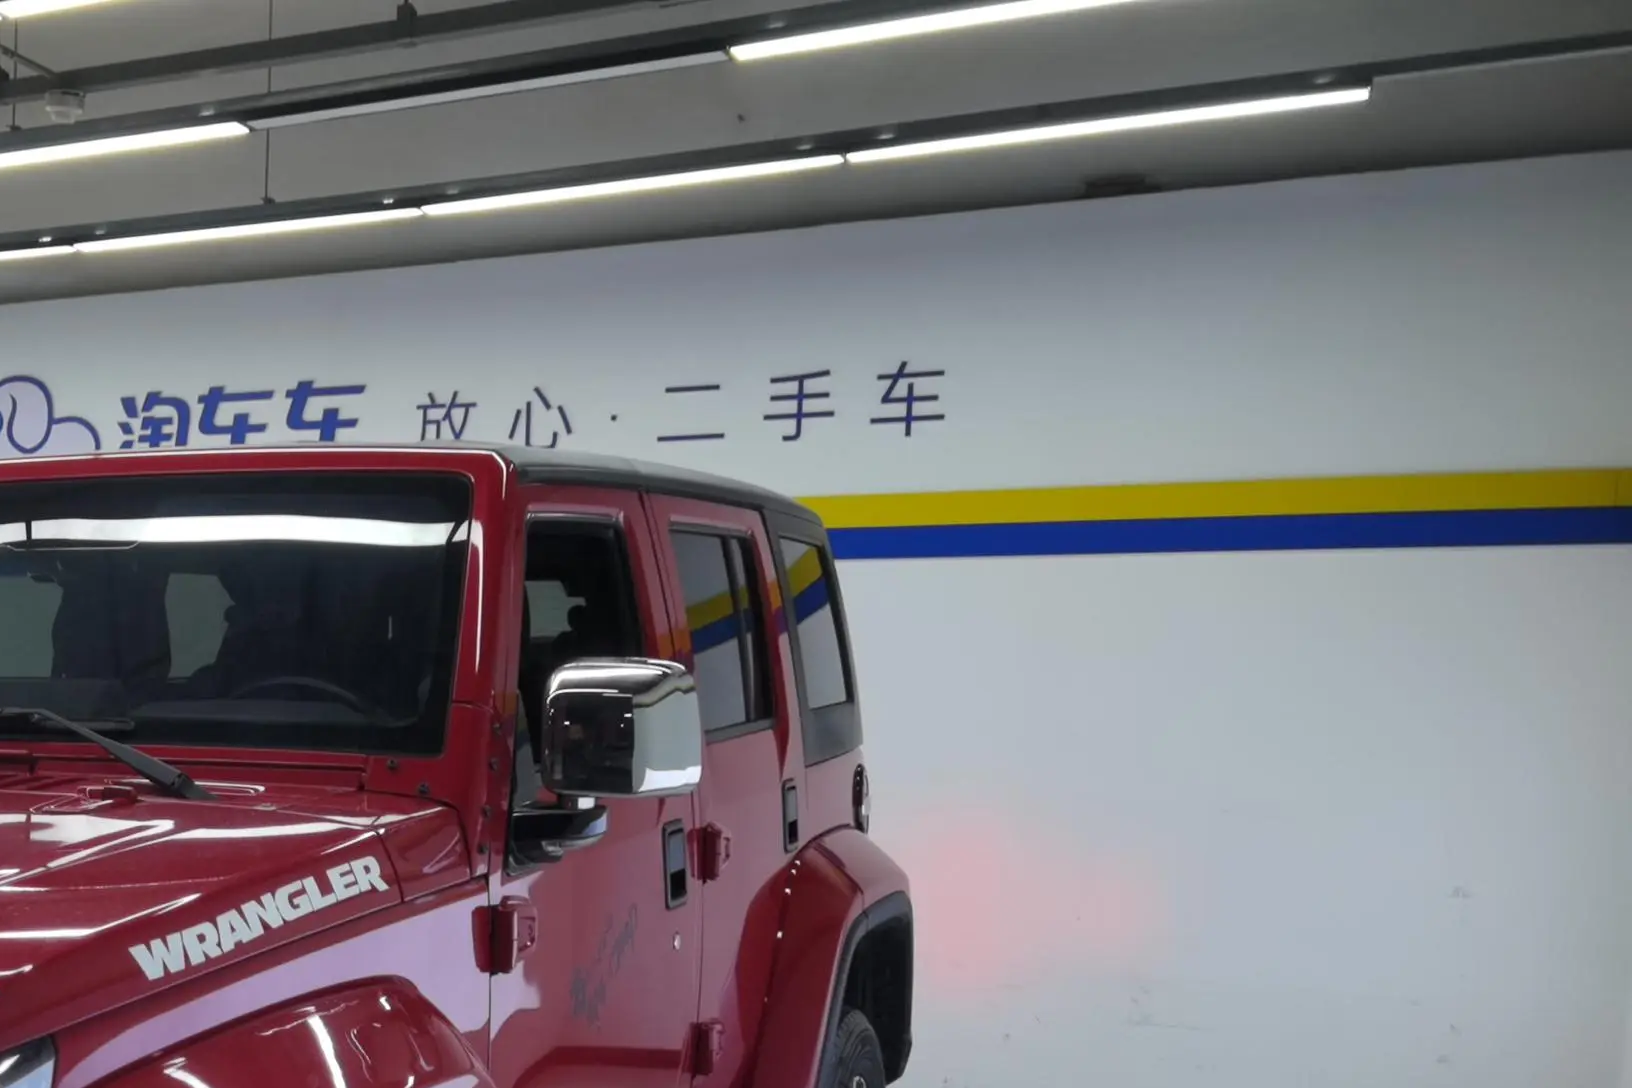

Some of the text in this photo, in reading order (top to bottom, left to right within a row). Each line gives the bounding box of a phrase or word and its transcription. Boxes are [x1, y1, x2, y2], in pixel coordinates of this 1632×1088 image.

[117, 380, 366, 448] 淘车车
[128, 855, 390, 981] WRANGLER
